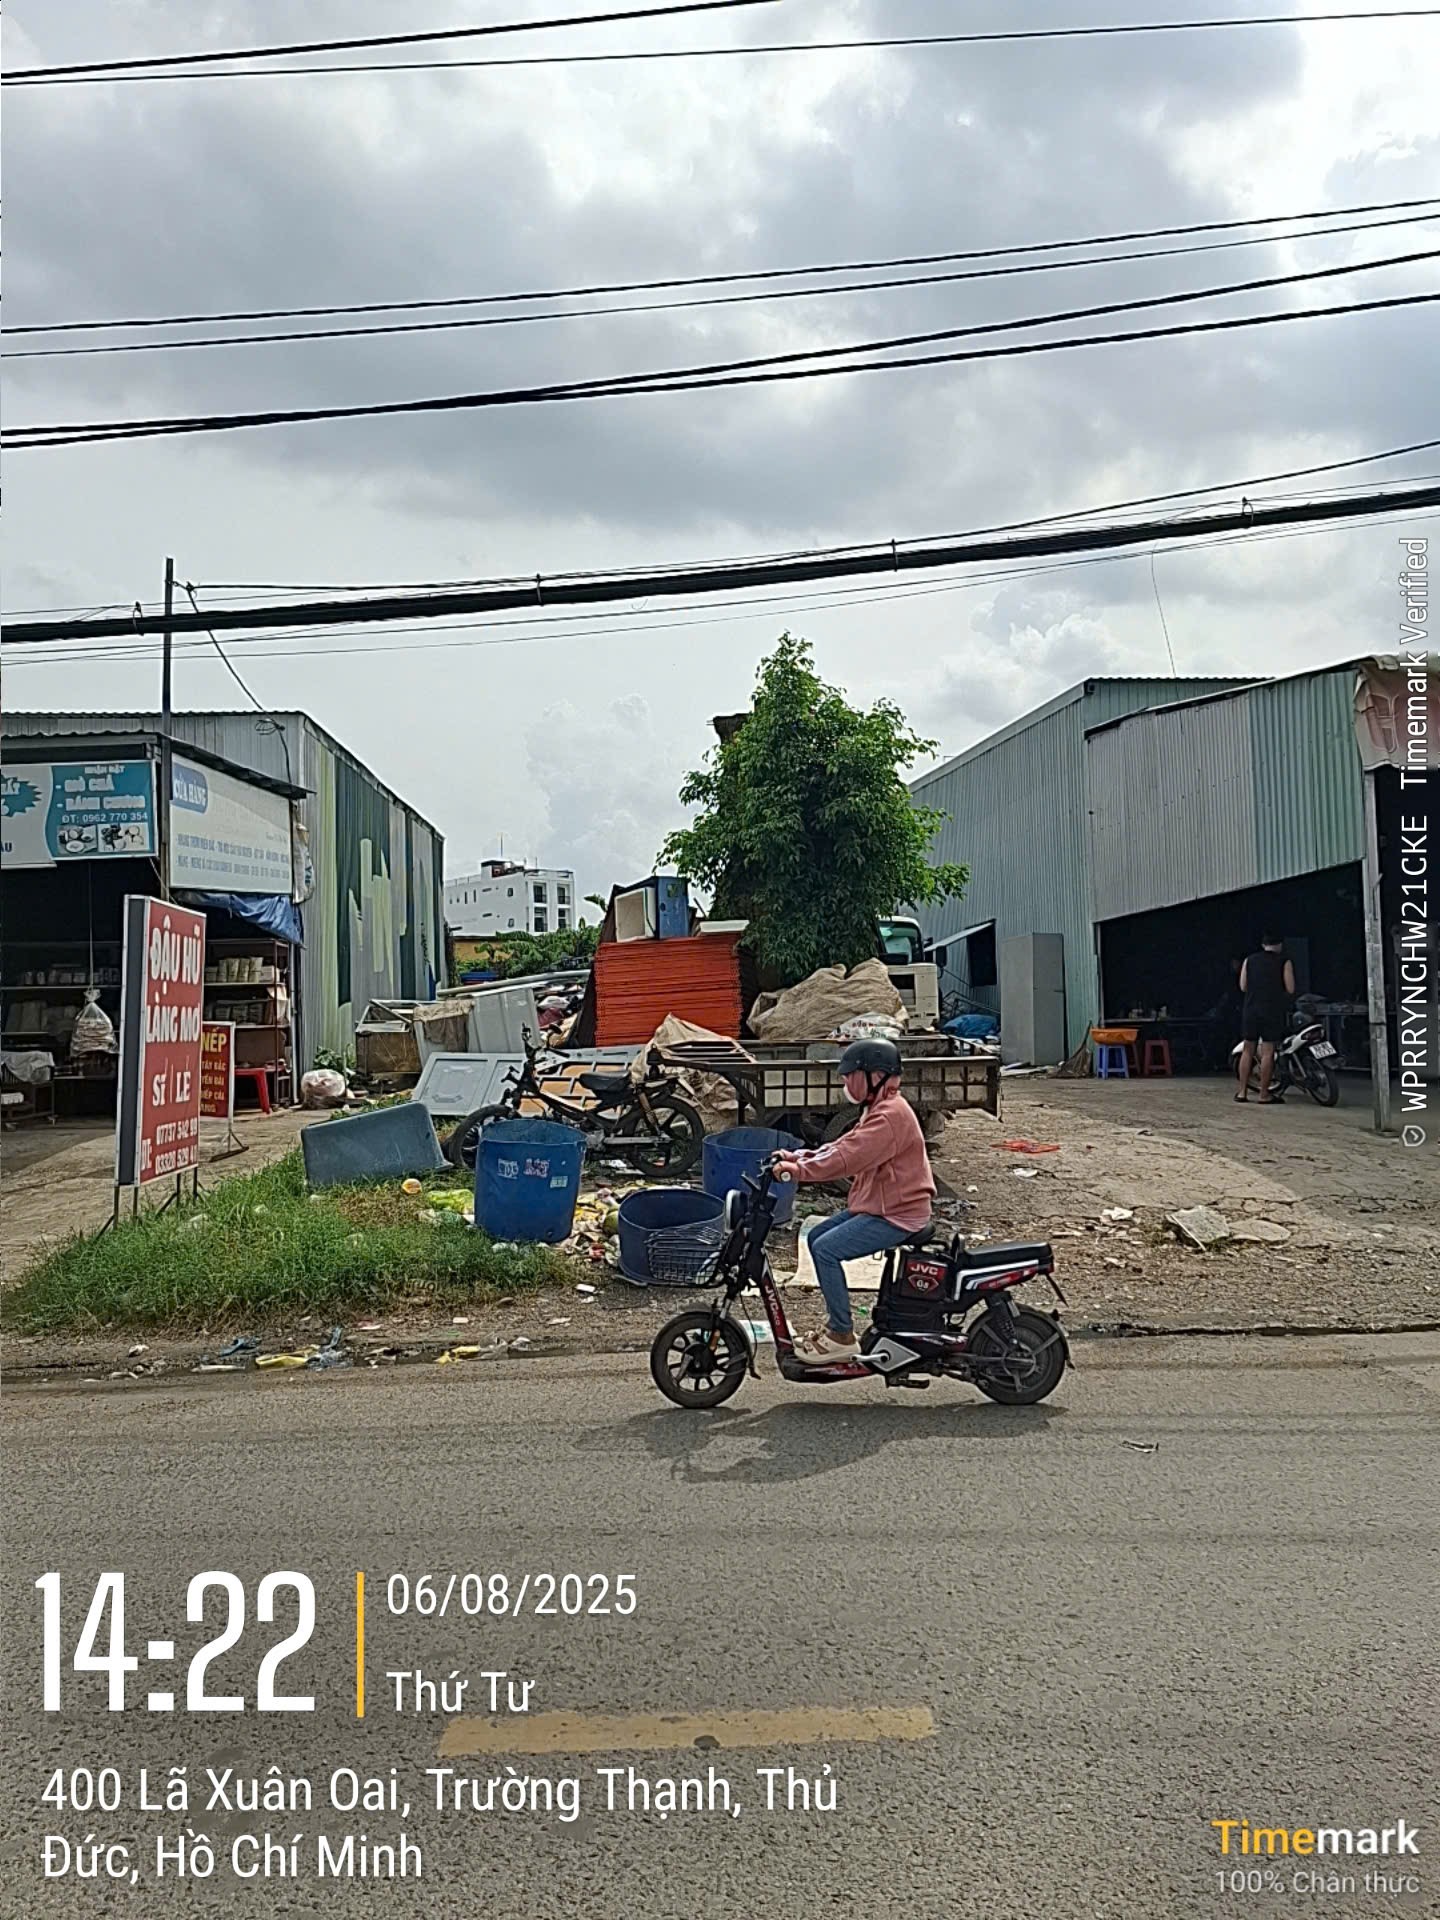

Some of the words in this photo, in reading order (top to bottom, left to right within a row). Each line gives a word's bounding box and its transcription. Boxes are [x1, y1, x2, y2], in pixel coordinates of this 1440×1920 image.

[109, 811, 128, 822] 770
[130, 810, 149, 821] 354
[150, 914, 181, 995] ĐẬU
[145, 990, 179, 1043] LÀNG
[910, 1262, 939, 1276] JVC
